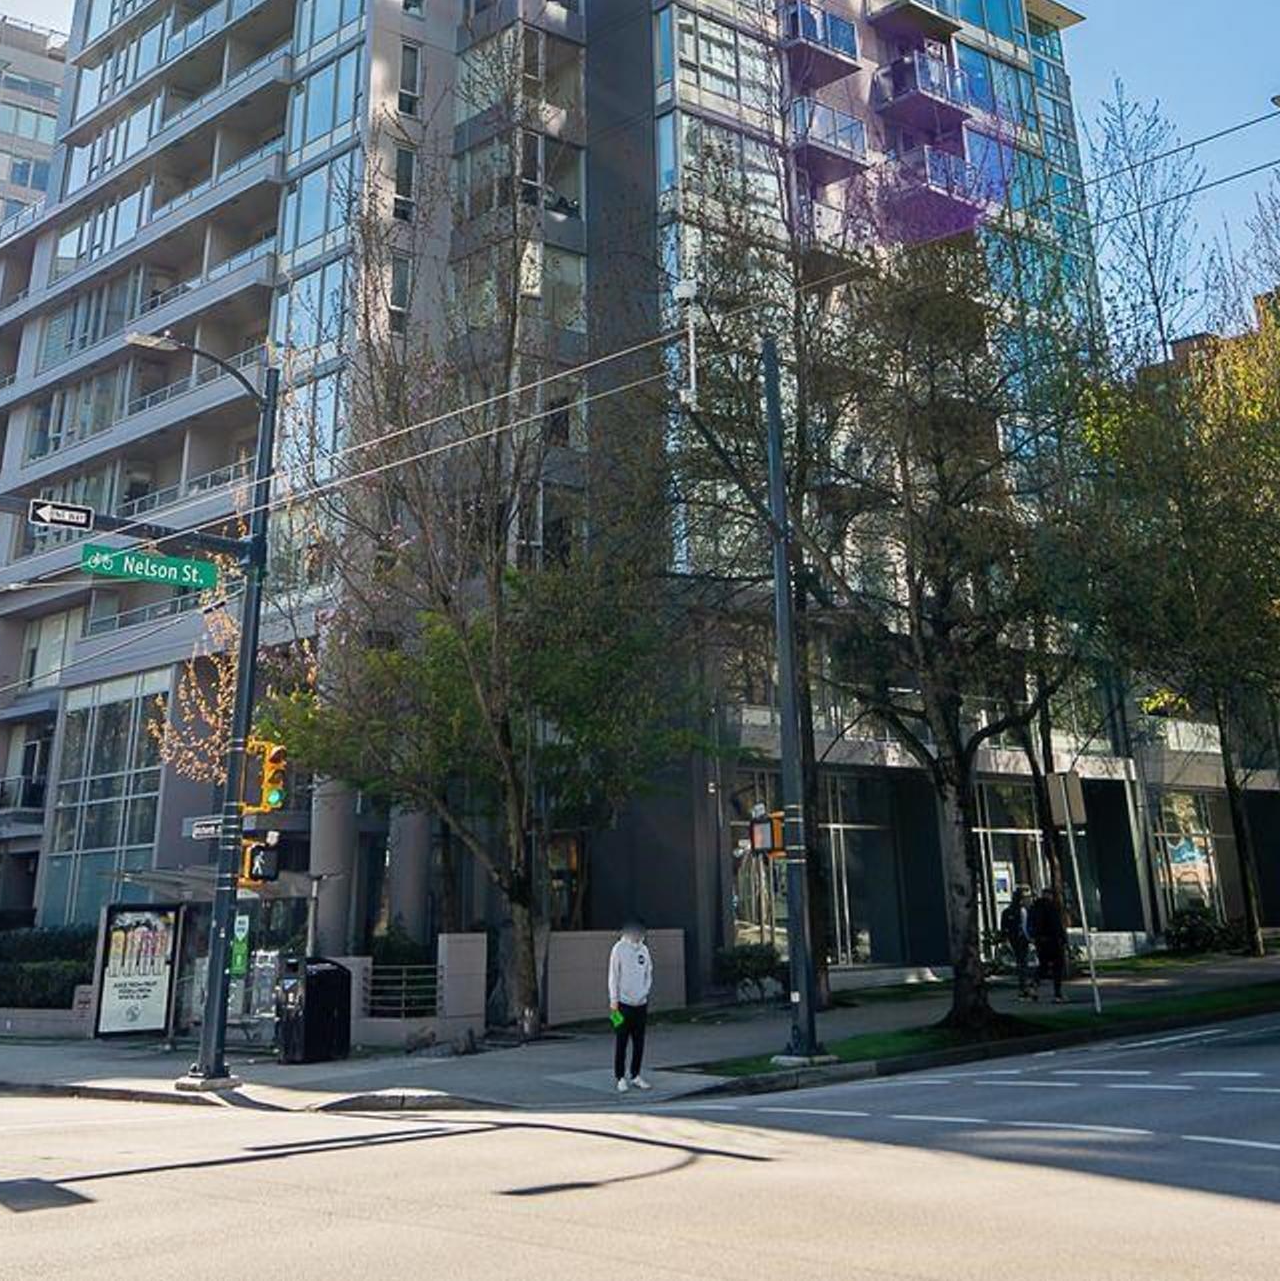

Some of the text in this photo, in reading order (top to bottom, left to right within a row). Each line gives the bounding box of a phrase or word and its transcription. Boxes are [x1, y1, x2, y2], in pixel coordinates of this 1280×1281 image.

[68, 512, 86, 523] WAY
[123, 556, 204, 584] Nelson St.
